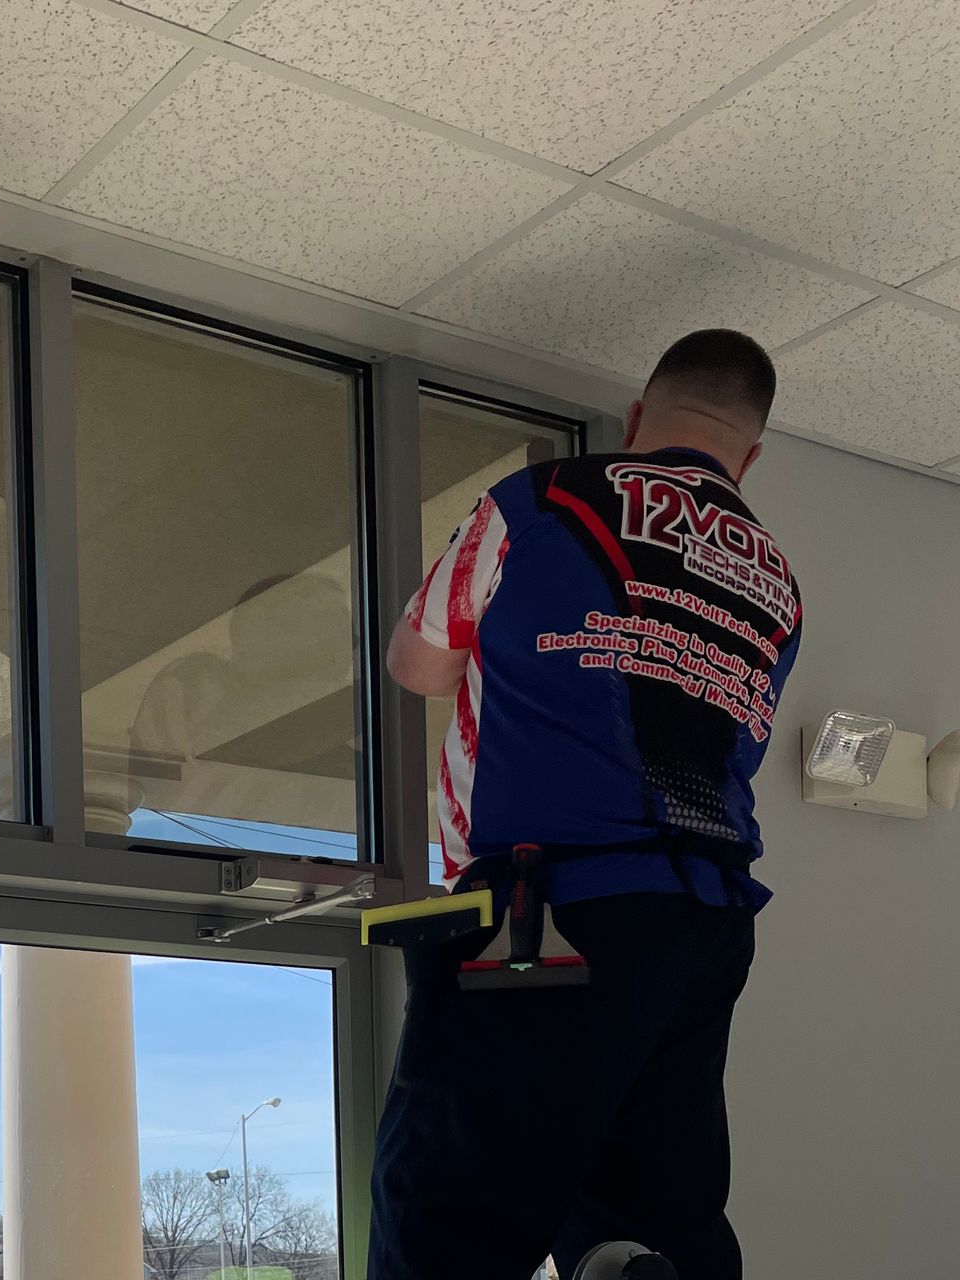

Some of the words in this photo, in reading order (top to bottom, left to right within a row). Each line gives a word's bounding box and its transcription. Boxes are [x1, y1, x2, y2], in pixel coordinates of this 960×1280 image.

[685, 553, 794, 634] INCORPORATED
[686, 536, 752, 582] TECHS
[584, 610, 690, 649] Specializing
[689, 632, 706, 655] in
[705, 642, 752, 682] Quality
[750, 668, 771, 693] 12
[626, 579, 779, 665] www.12VoltTechs.com
[537, 630, 639, 653] Electronics
[641, 637, 678, 663] Plus
[676, 650, 751, 705] Automotive,
[580, 652, 615, 669] and
[616, 653, 707, 698] Commecial
[704, 682, 751, 724] Window
